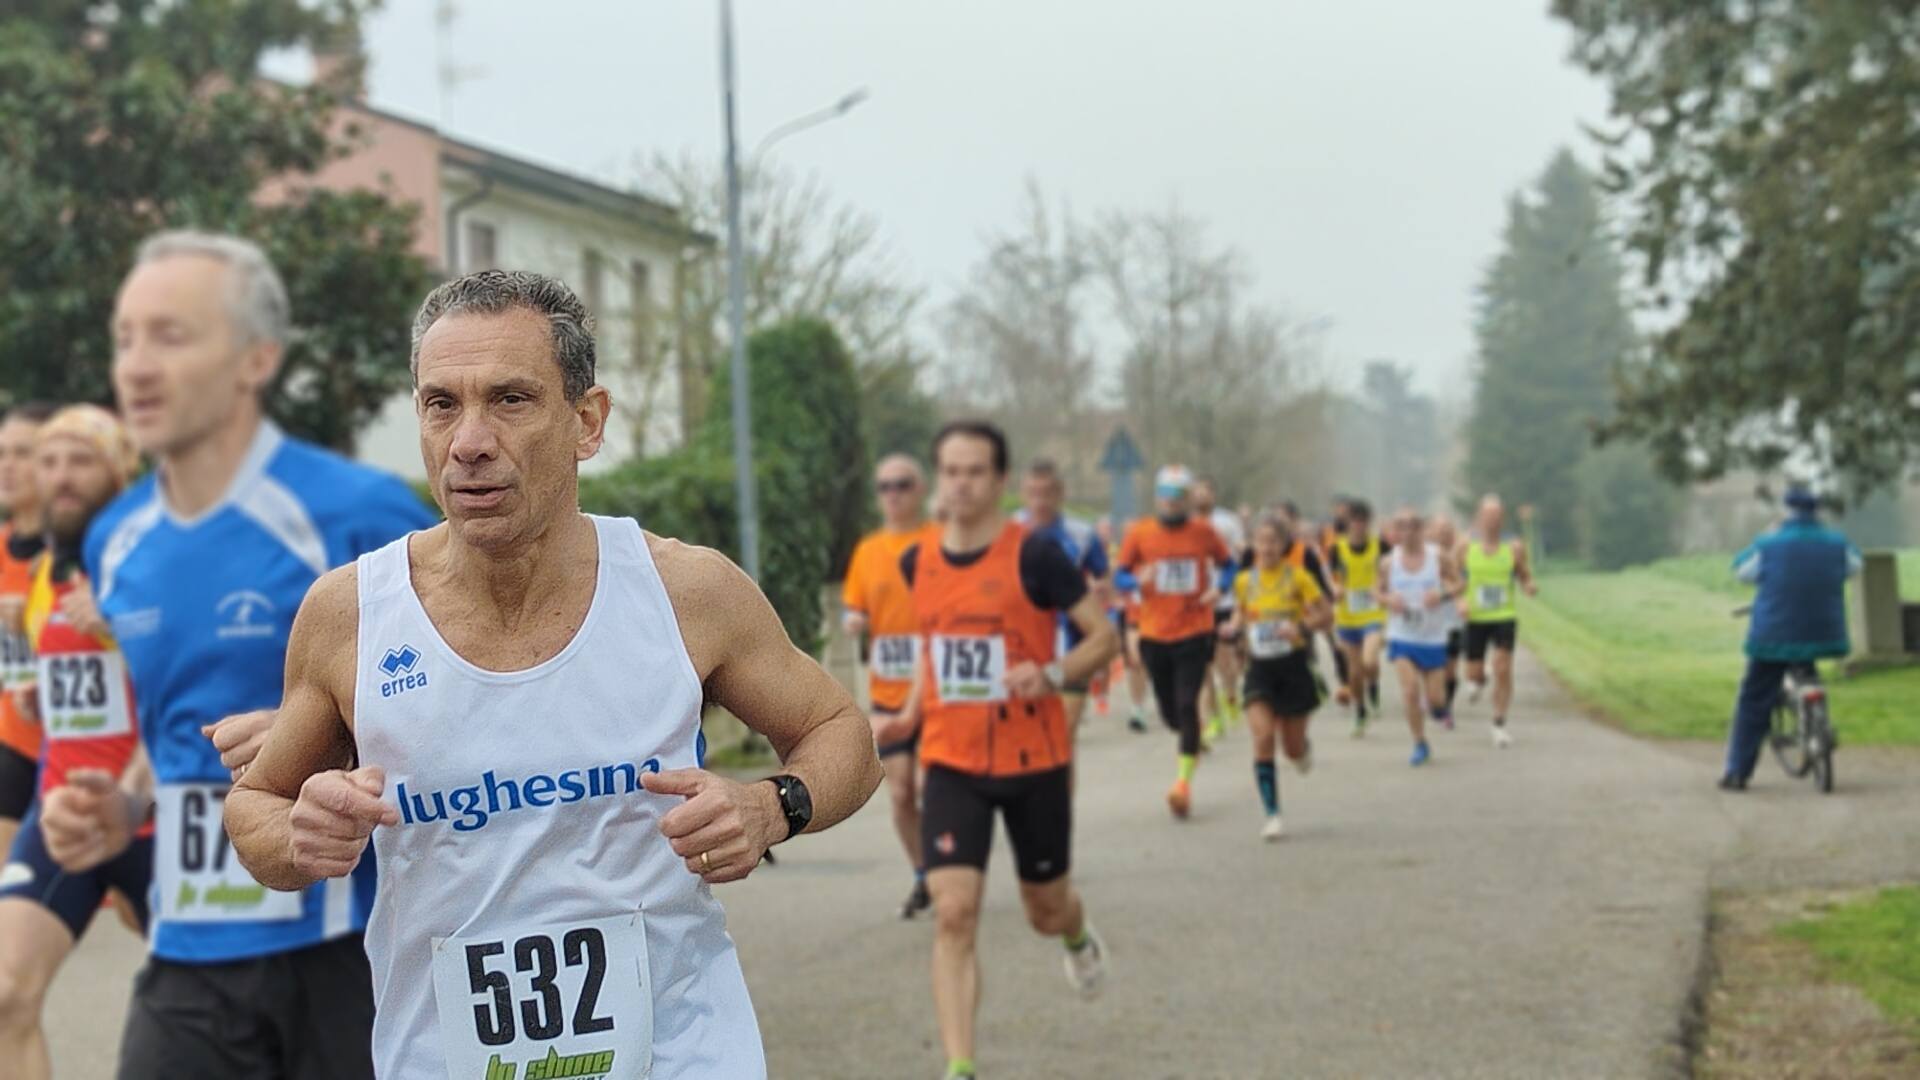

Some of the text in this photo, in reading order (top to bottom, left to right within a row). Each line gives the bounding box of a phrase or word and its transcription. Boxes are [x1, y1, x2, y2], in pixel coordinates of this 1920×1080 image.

[49, 656, 107, 710] 623
[381, 671, 428, 698] errea
[942, 637, 992, 680] 752
[181, 789, 230, 872] 67
[464, 927, 615, 1046] 532
